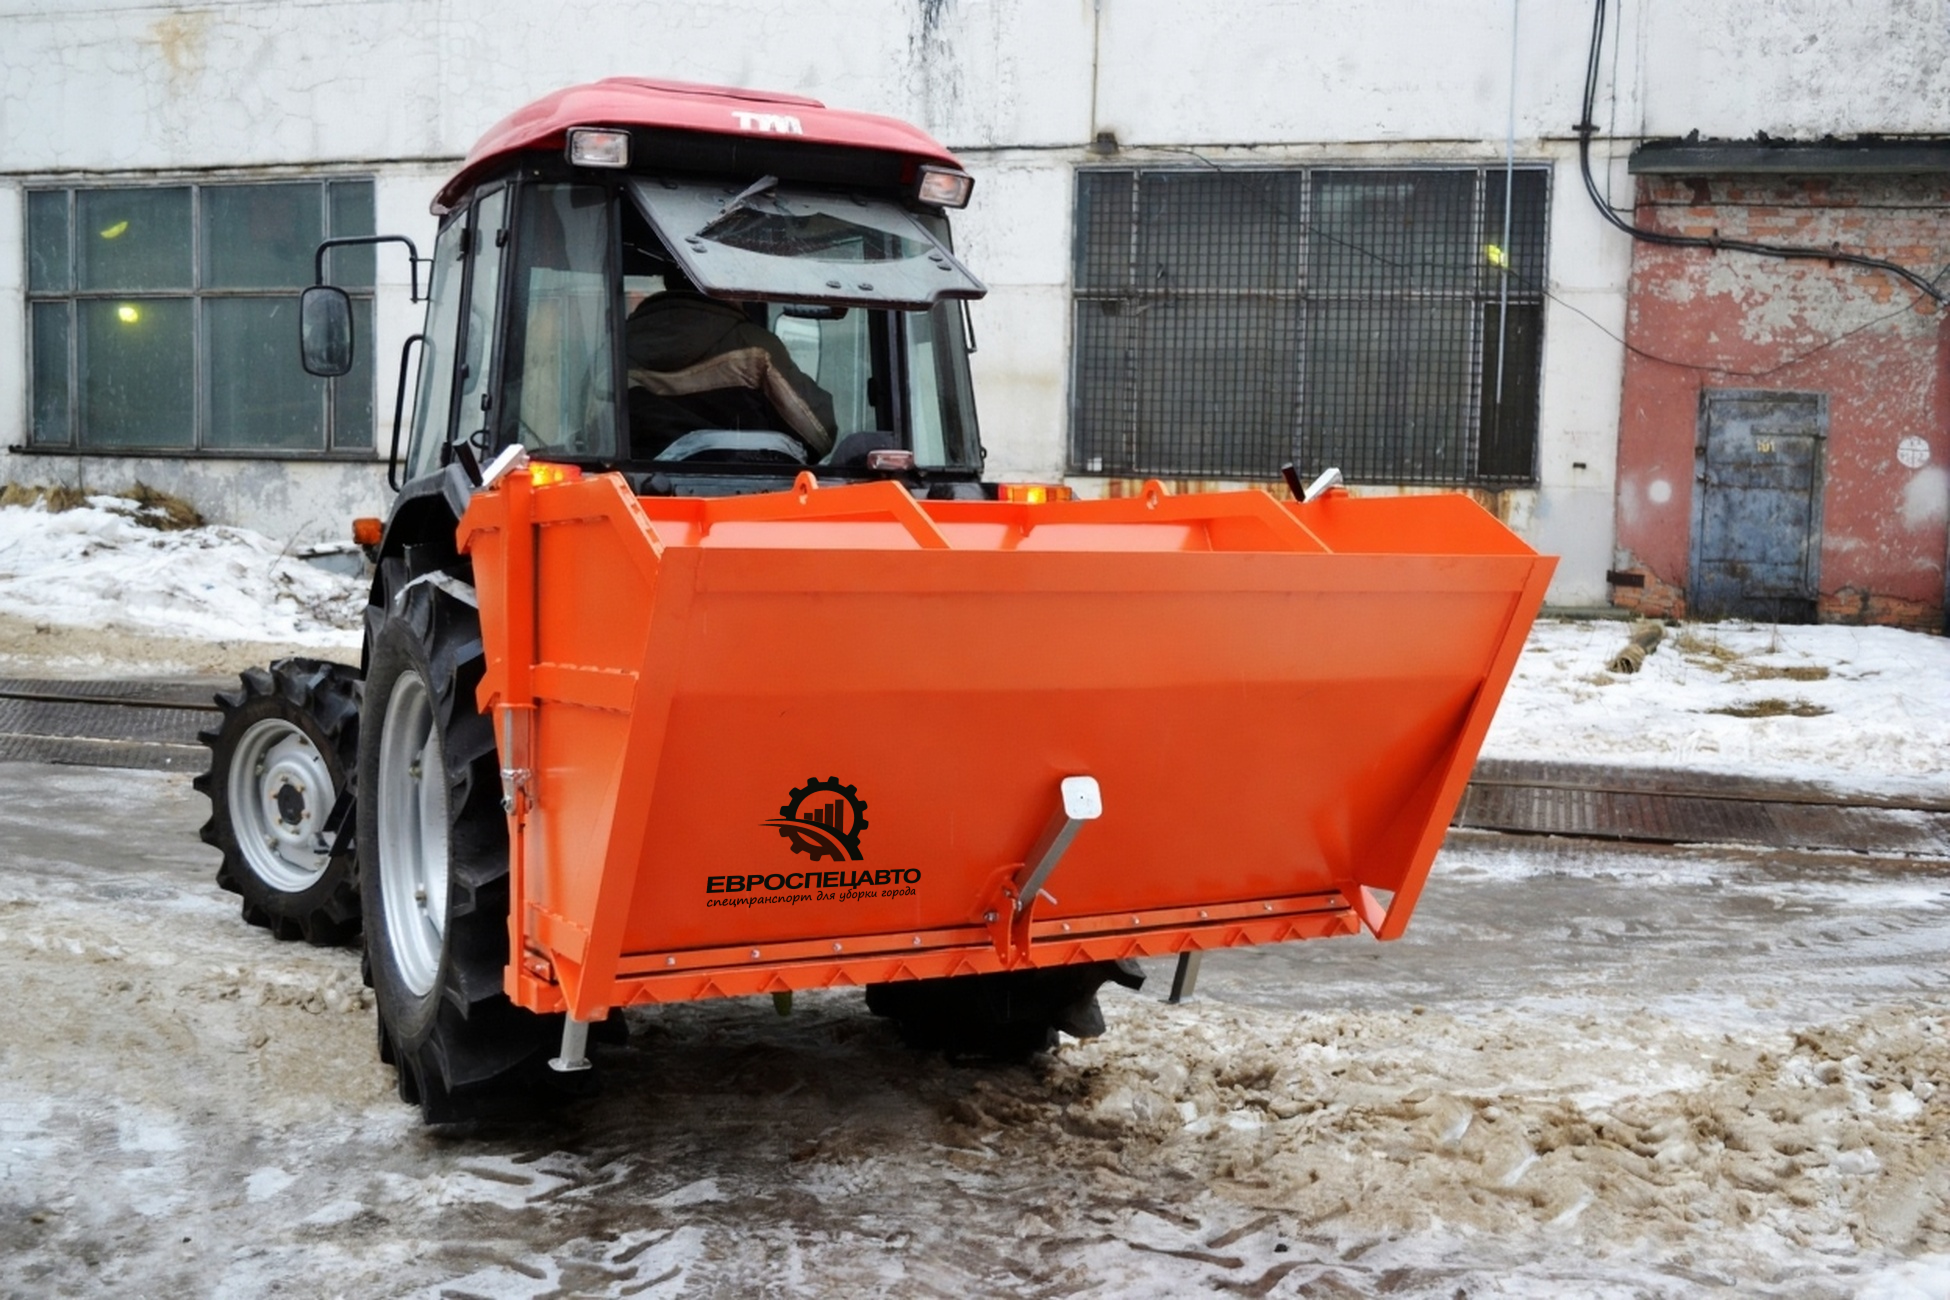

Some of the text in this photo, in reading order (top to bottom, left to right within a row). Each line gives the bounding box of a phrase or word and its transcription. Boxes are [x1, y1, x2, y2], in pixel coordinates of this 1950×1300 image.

[706, 868, 922, 893] ЕВРОСПЕЦАВТО
[706, 886, 917, 908] спецтранспорт для уборки города
